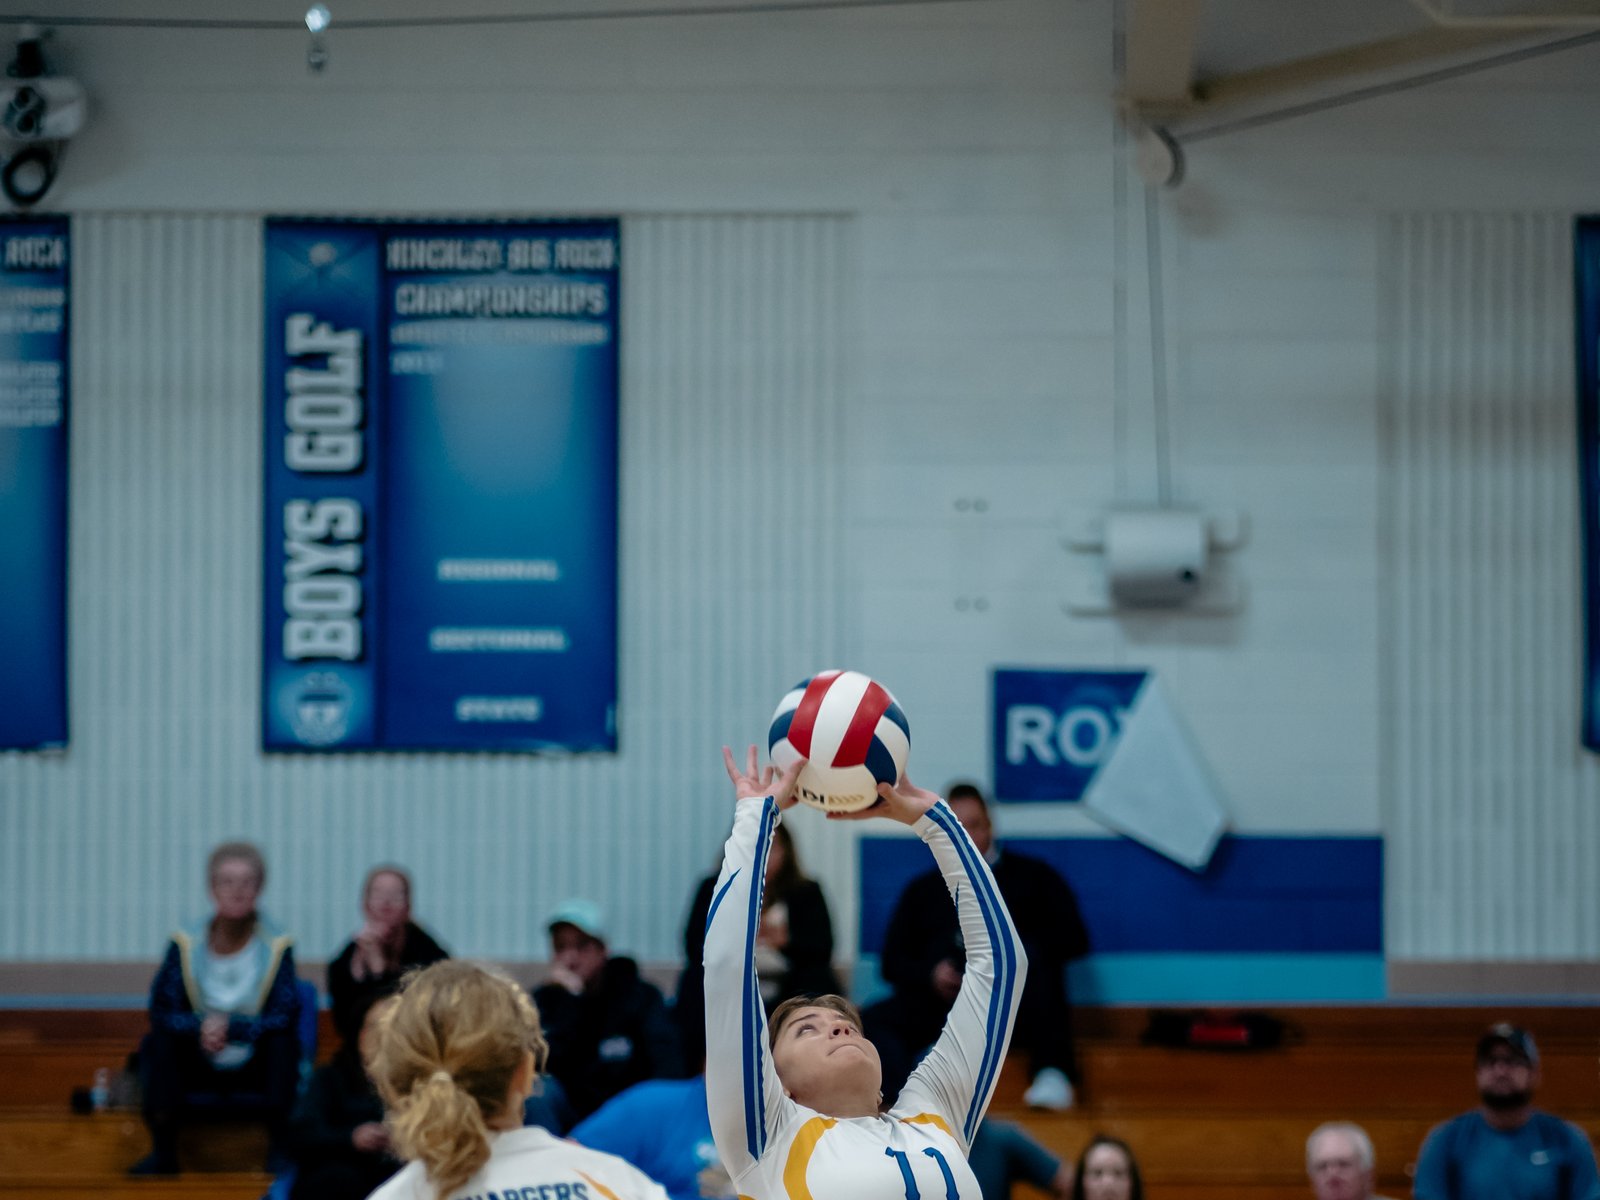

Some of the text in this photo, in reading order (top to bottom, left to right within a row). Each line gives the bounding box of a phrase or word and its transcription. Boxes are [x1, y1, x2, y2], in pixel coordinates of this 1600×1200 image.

[396, 282, 608, 316] CHAMPIONSHIPS
[283, 313, 362, 660] BOYS GOLF
